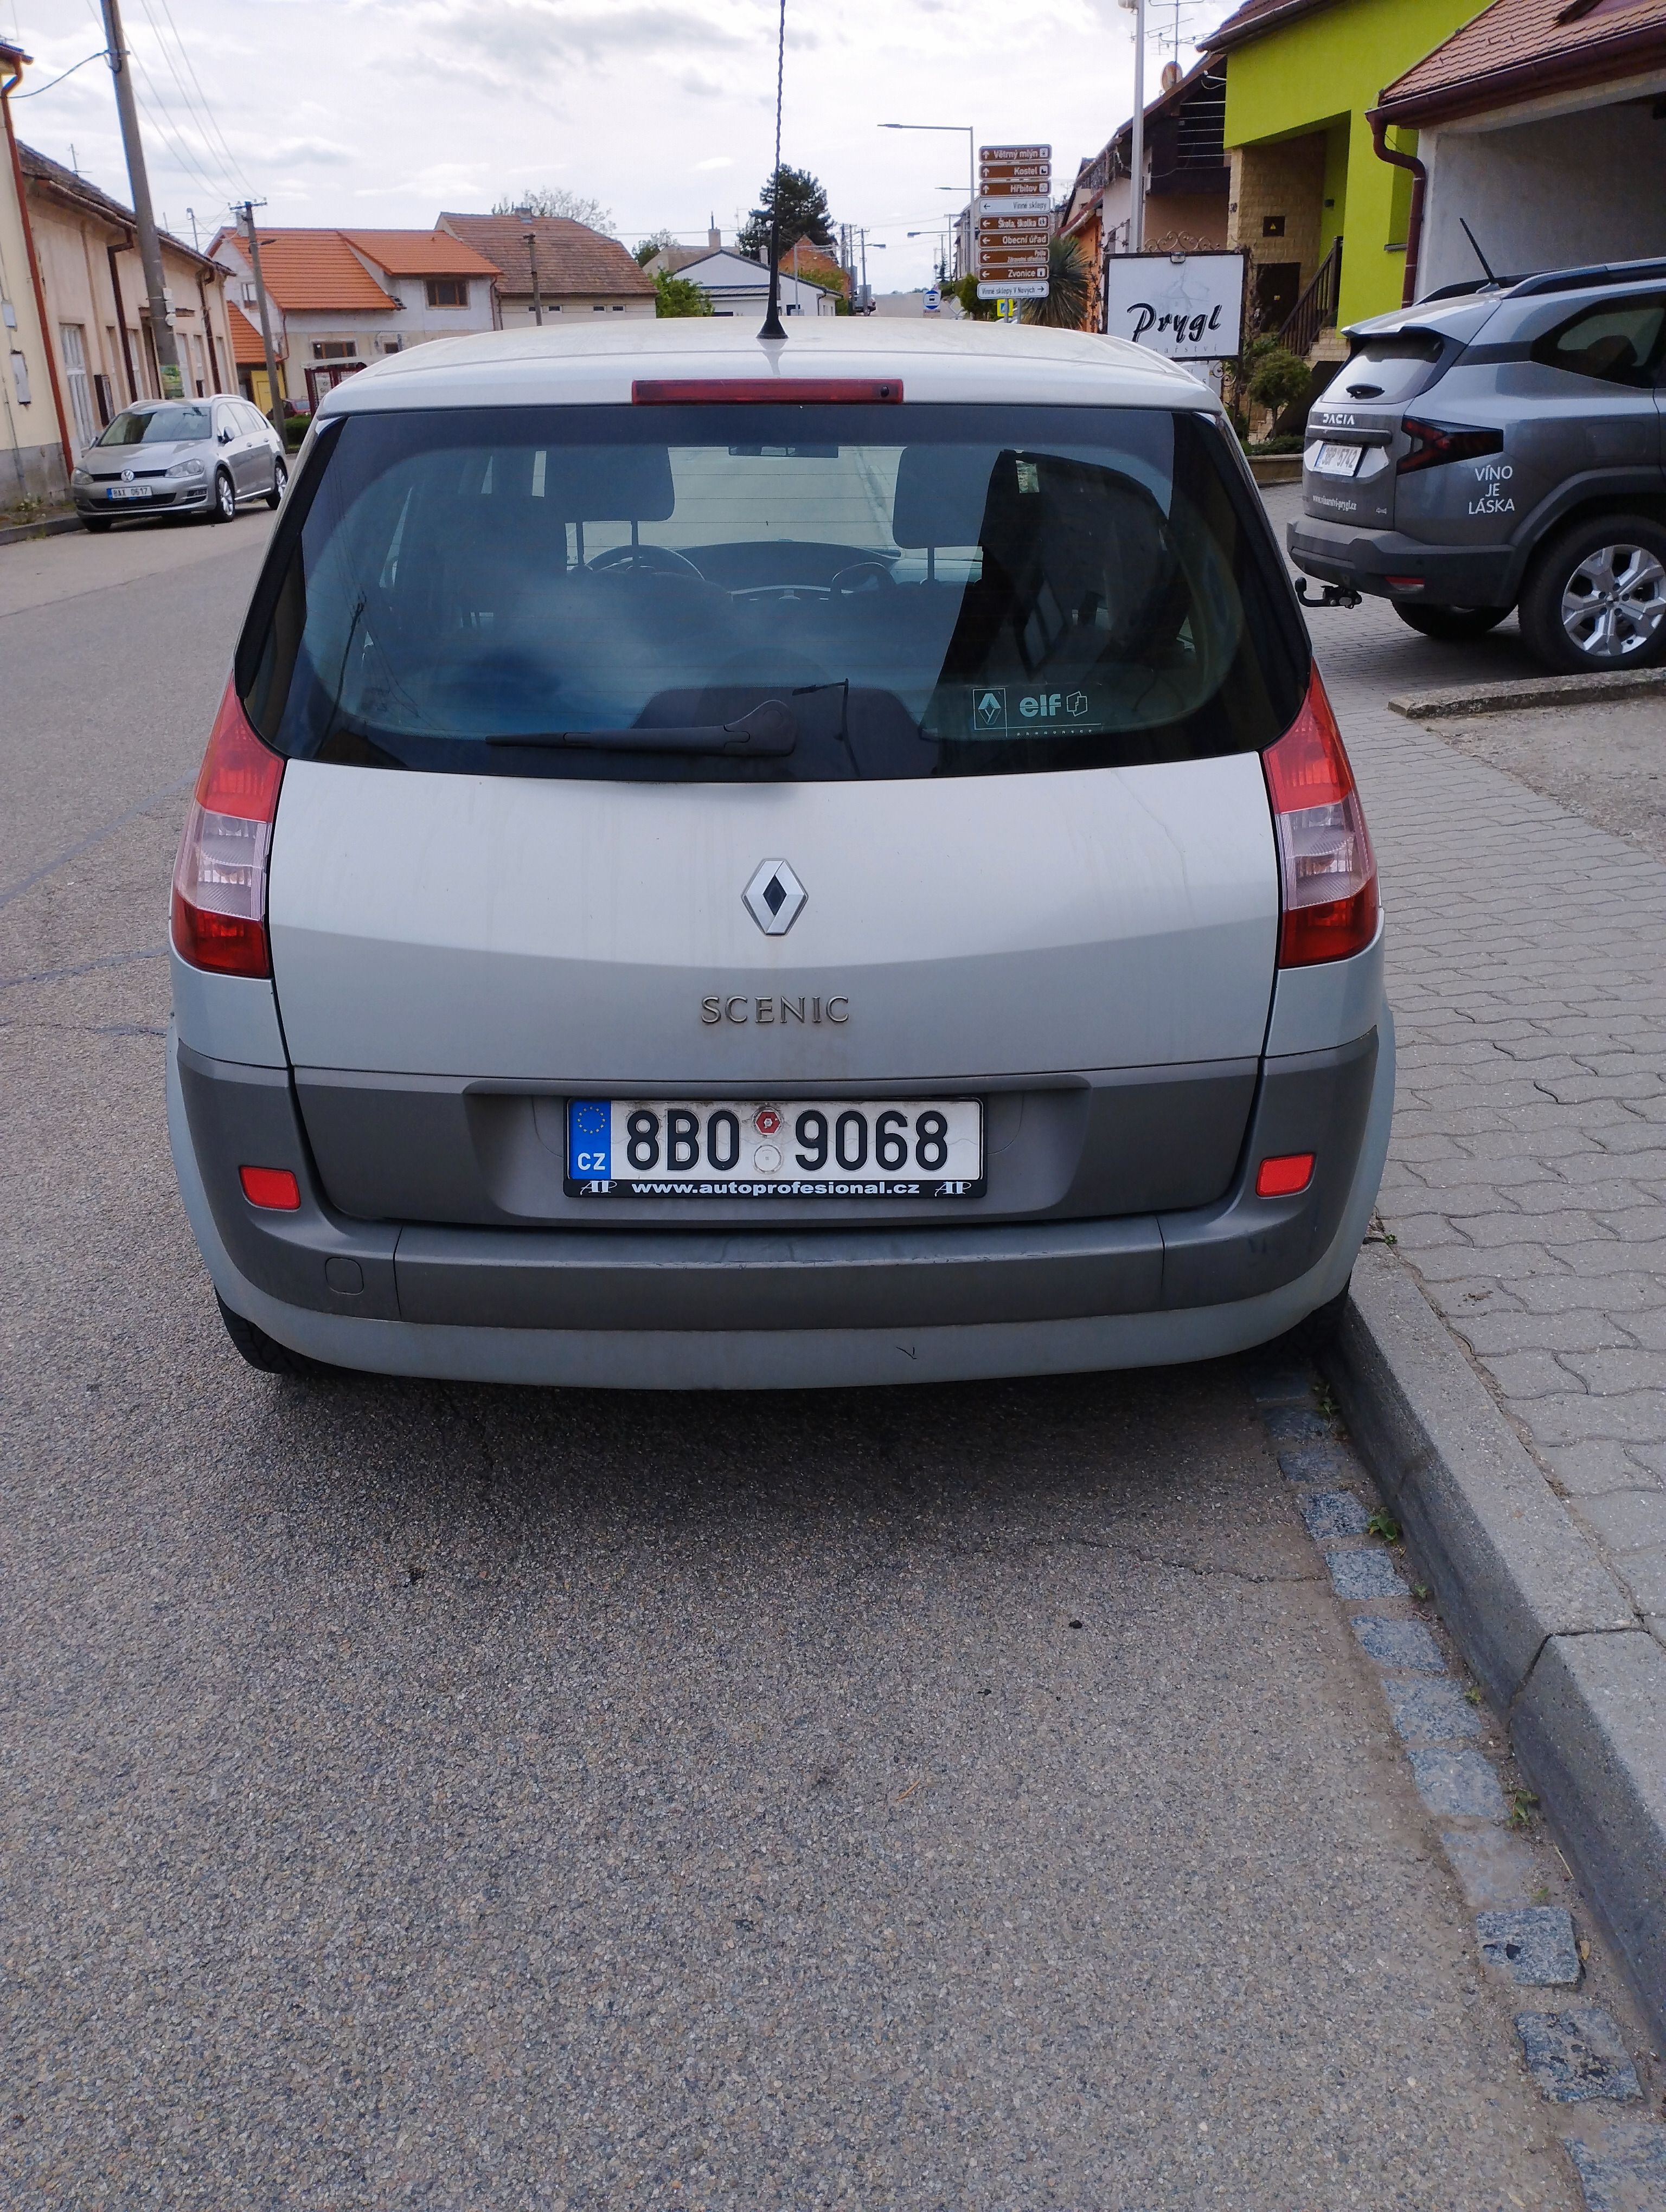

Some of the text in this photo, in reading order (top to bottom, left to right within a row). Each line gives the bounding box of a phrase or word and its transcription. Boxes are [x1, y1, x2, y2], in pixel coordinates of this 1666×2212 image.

[1014, 166, 1037, 175] Kostel
[1002, 235, 1046, 244] Obecní úřad
[1008, 269, 1036, 278] Zvonice
[1127, 303, 1222, 343] Prygl
[1474, 465, 1513, 481] VÍNO
[1485, 483, 1501, 497] JE
[1468, 498, 1516, 515] LÁSKA
[1020, 694, 1061, 717] elf
[701, 995, 849, 1023] SCENIC
[627, 1109, 949, 1172] 8B0 9068
[578, 1153, 605, 1171] CZ
[631, 1181, 920, 1197] www.autoprofesional.cz
